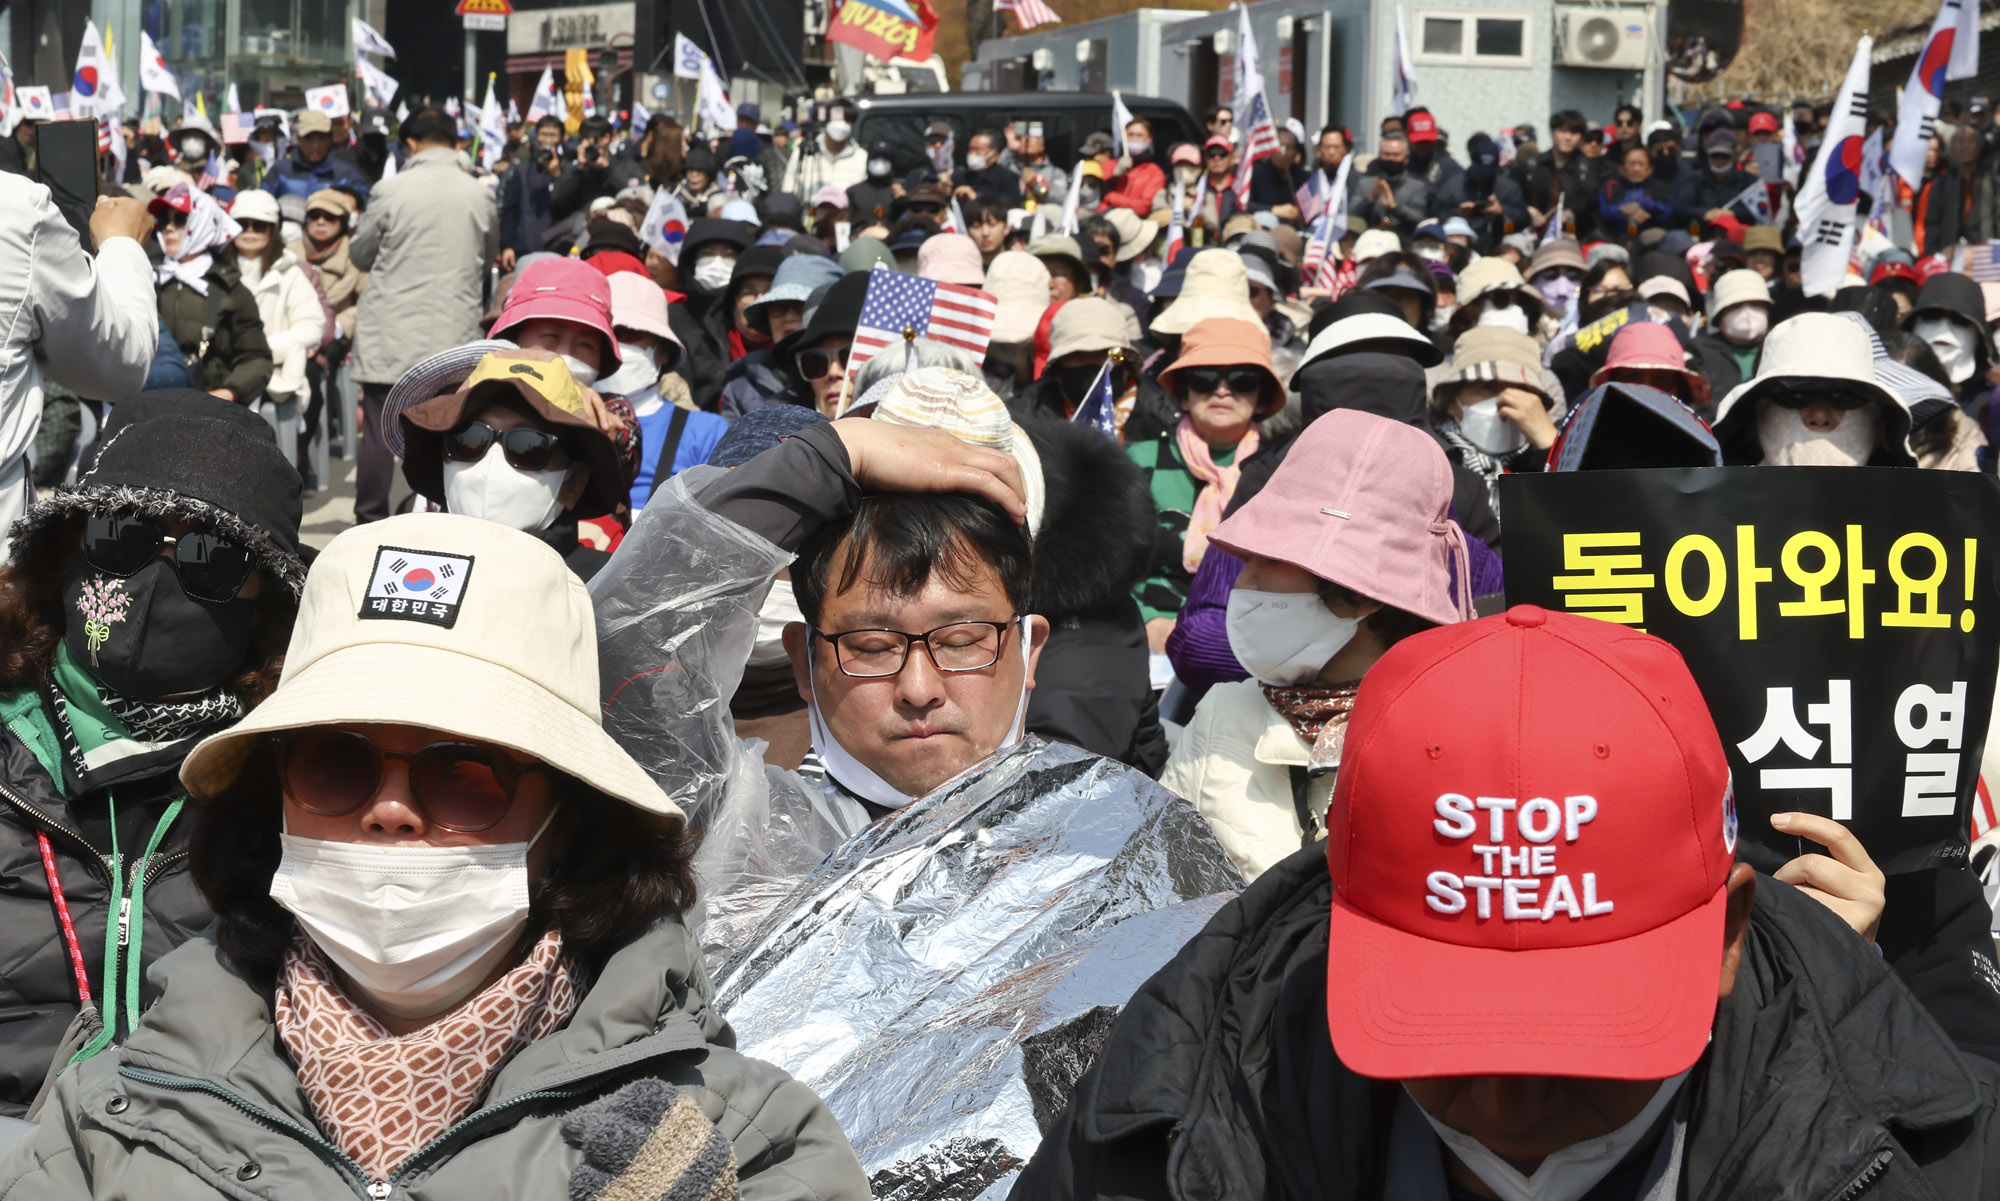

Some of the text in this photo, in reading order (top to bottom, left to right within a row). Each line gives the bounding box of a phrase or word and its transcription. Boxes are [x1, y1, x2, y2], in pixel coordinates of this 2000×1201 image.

[1553, 524, 1978, 641] 돌아와요!
[371, 598, 449, 619] 대한민국
[1433, 793, 1598, 843] STOP
[1472, 844, 1557, 876] THE
[1425, 870, 1615, 922] STEAL
